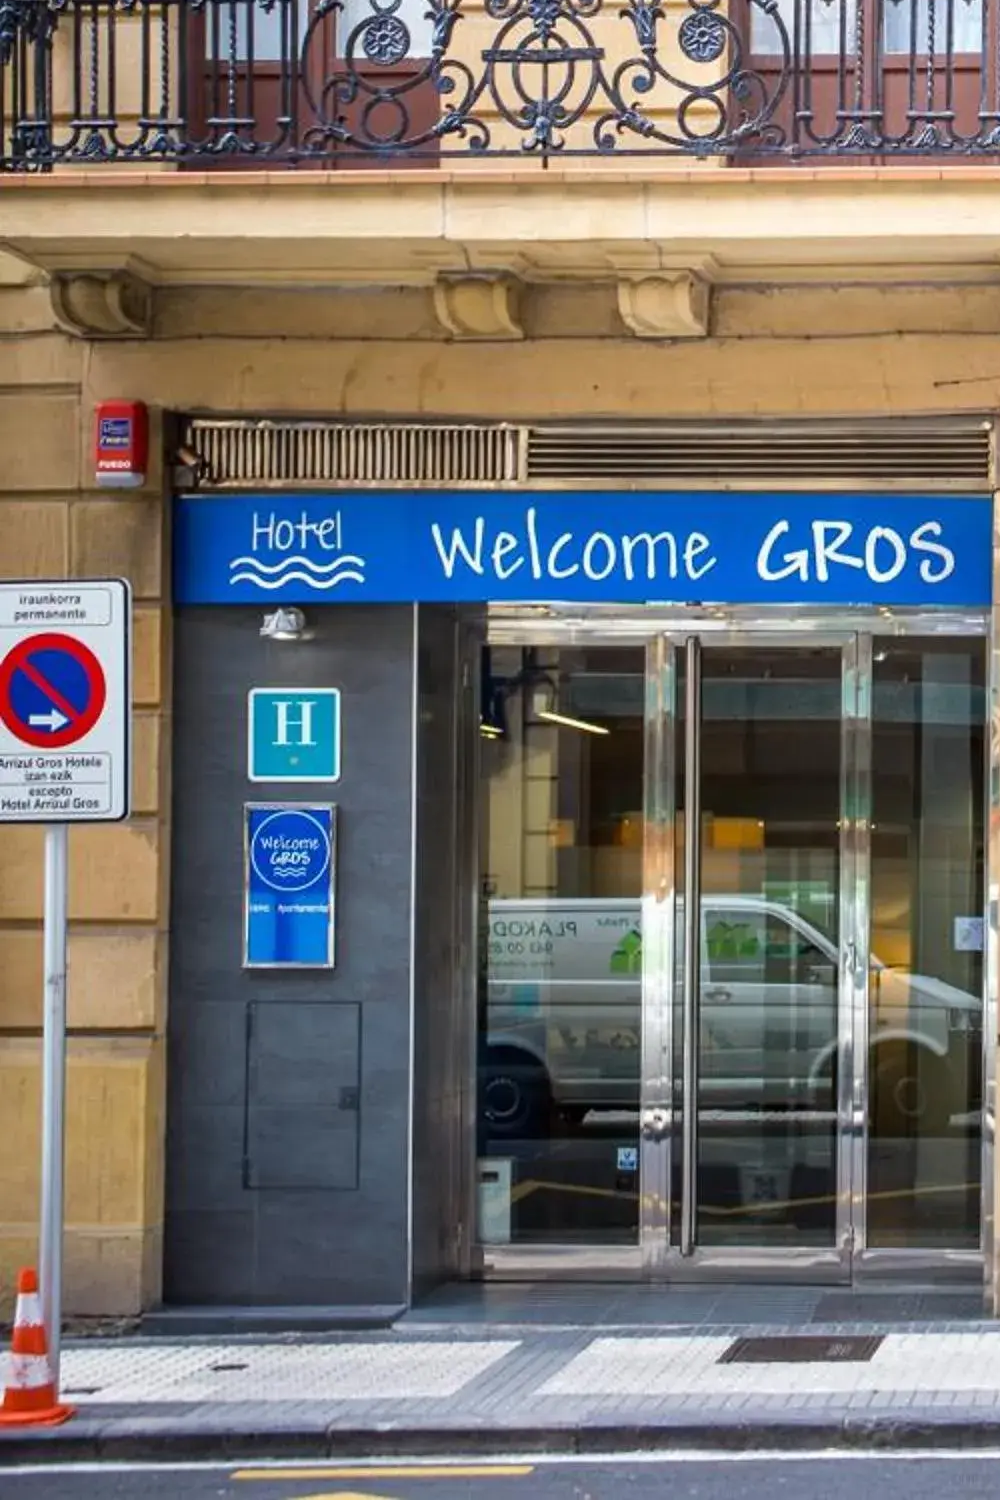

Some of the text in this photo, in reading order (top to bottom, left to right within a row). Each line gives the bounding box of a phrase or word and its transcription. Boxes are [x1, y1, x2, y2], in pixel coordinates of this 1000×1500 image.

[252, 512, 342, 551] Hotel
[431, 508, 955, 583] Welcome GROS
[14, 609, 86, 622] permanente
[272, 701, 317, 746] H
[1, 799, 31, 811] Hotel
[73, 797, 99, 809] Gros
[260, 835, 320, 850] Welcome
[270, 850, 311, 865] GROS
